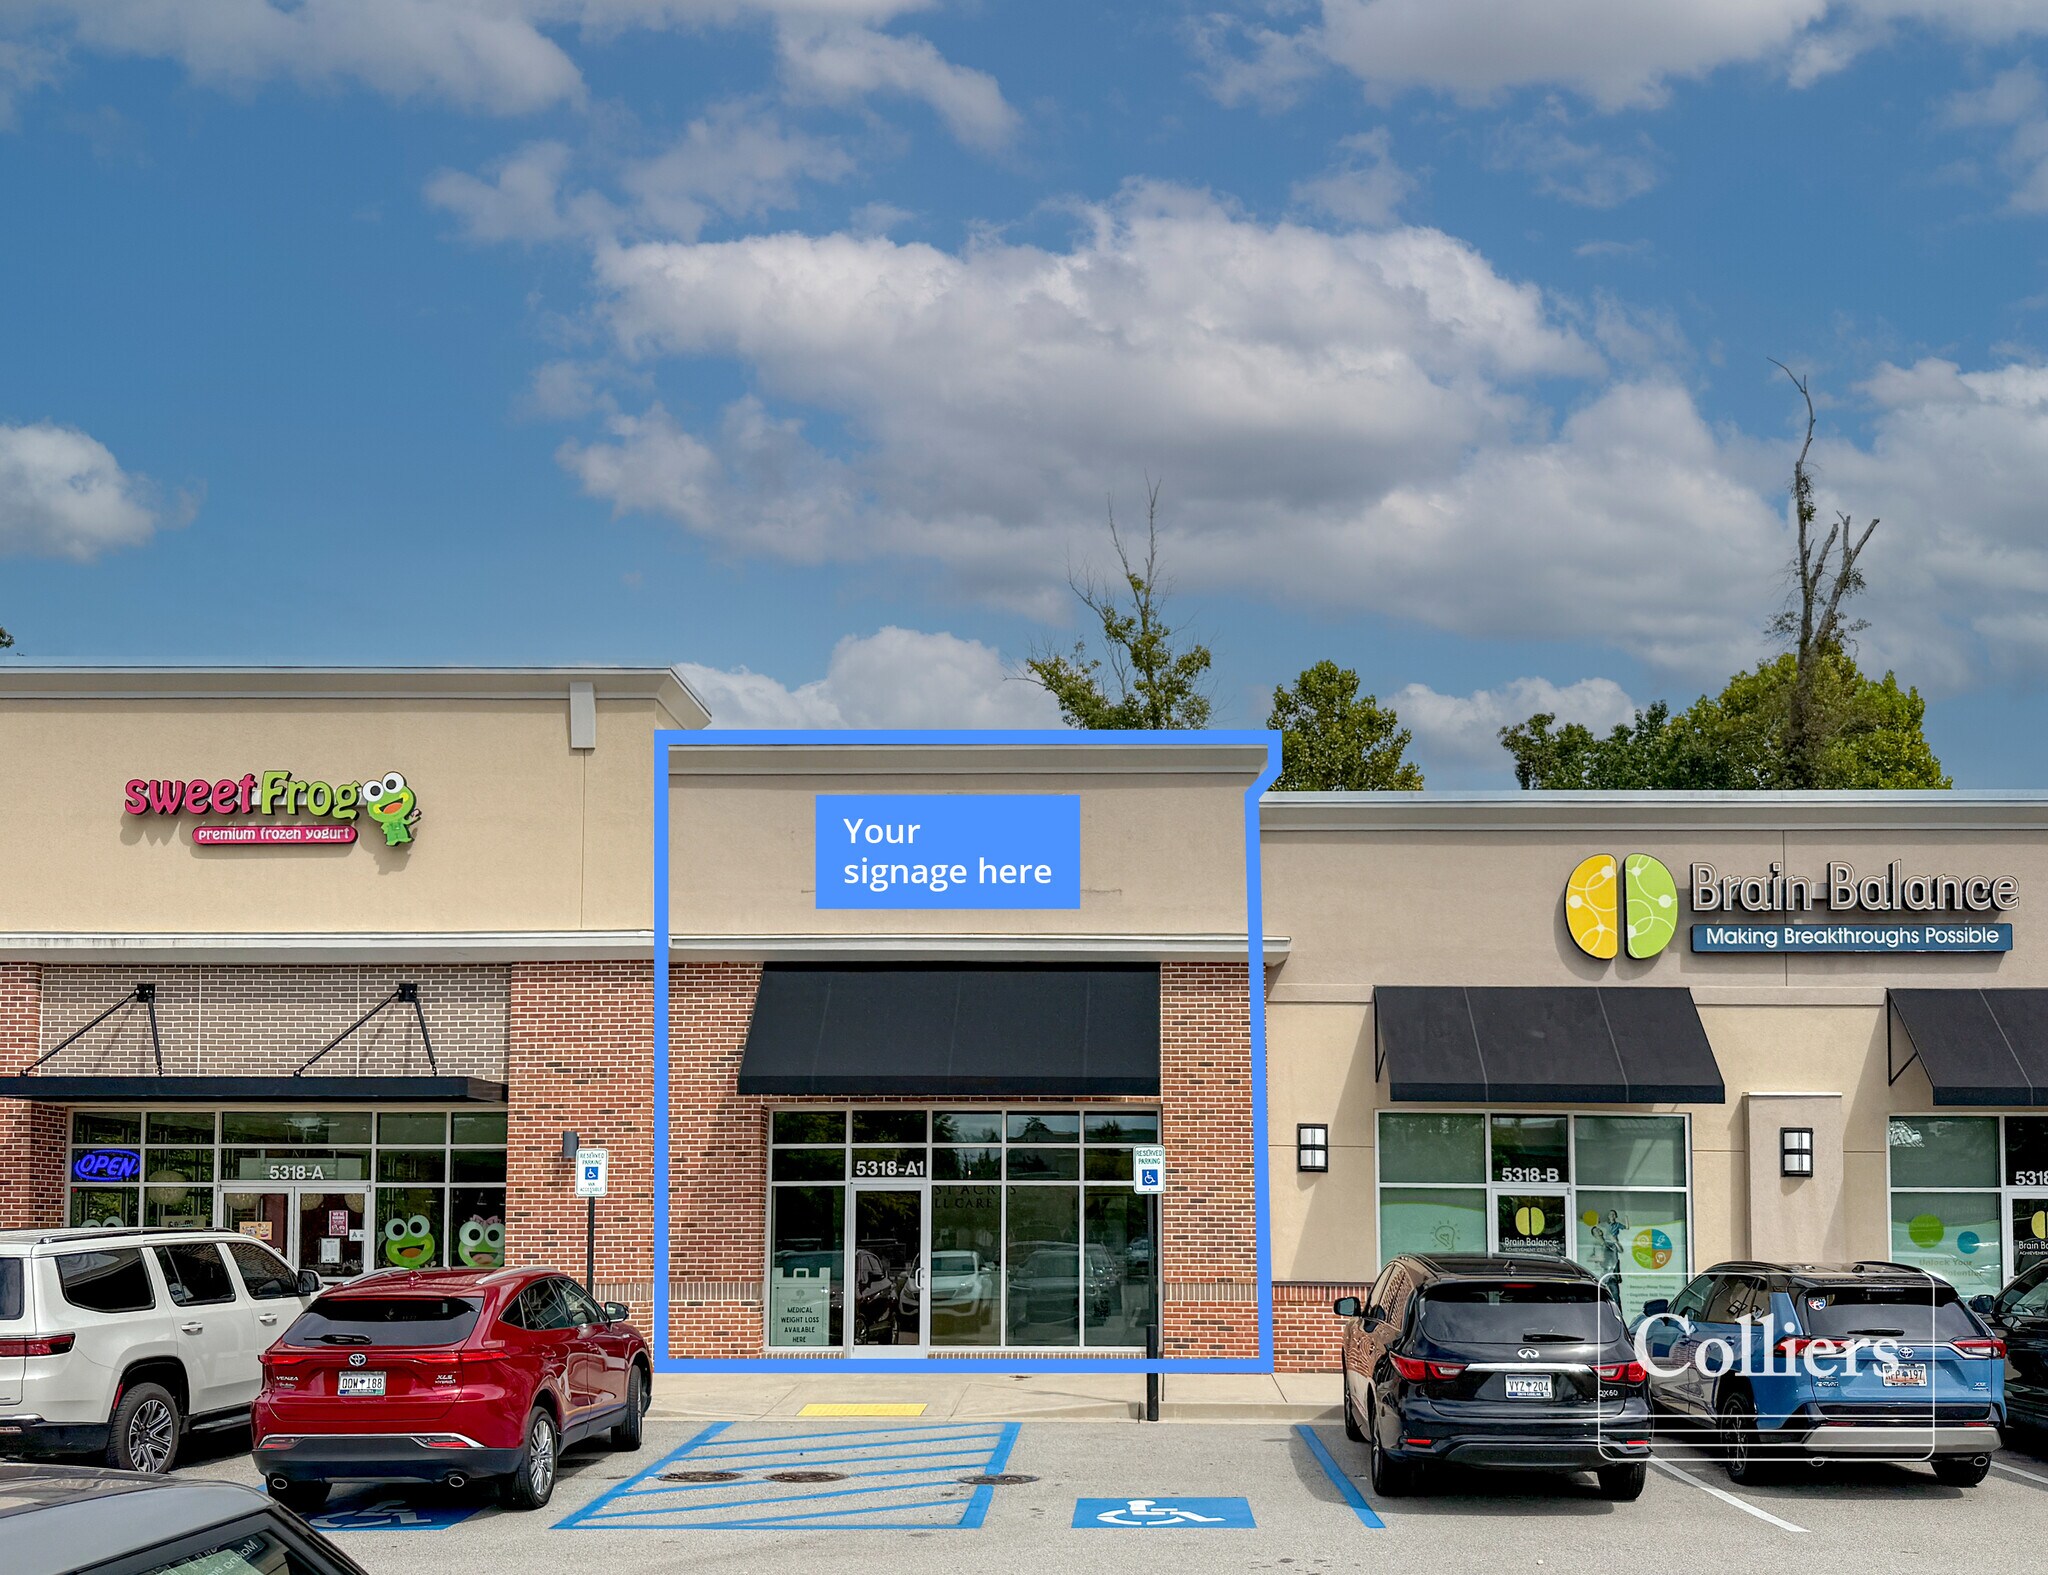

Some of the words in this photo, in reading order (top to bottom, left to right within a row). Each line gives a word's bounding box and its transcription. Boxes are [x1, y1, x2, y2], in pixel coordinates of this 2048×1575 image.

[198, 827, 256, 841] premium
[260, 827, 301, 841] frozen
[305, 827, 350, 841] yogurt
[1691, 861, 1812, 911] Brain
[1827, 859, 2020, 911] Balance
[1706, 927, 1778, 948] Making
[1784, 926, 1920, 948] Breakthroughs
[1925, 926, 2000, 944] Possible
[1136, 1149, 1163, 1157] RESERVED
[80, 1154, 136, 1177] OPEN
[855, 1160, 925, 1176] 5318-A1
[1138, 1157, 1161, 1165] PARKING
[269, 1165, 324, 1180] 5318-A
[1502, 1167, 1559, 1182] 5318-B
[1504, 1237, 1523, 1246] Brain
[1526, 1237, 1558, 1246] Balance
[2018, 1241, 2039, 1250] Brain
[787, 1306, 813, 1314] MEDICAL
